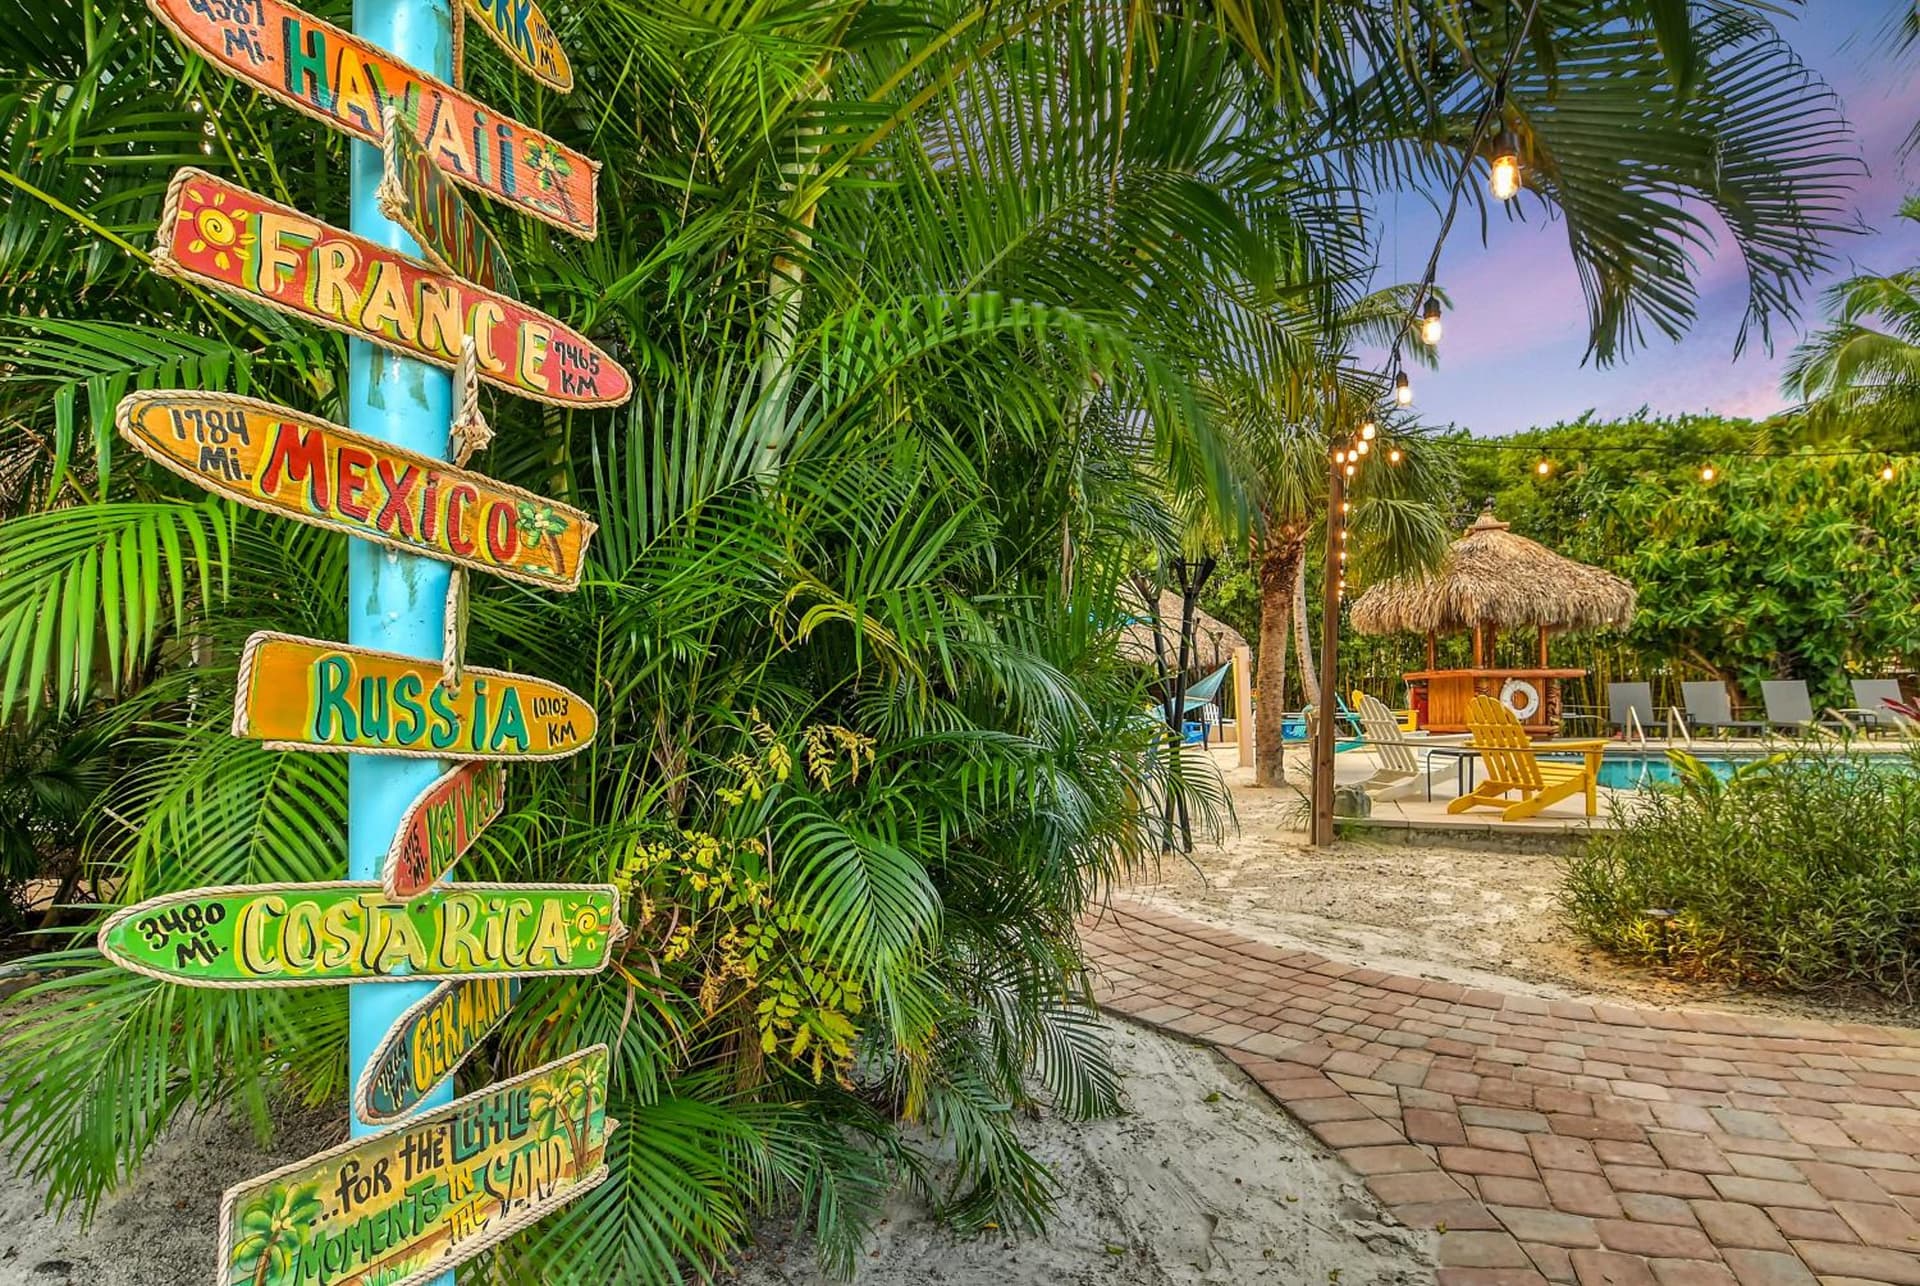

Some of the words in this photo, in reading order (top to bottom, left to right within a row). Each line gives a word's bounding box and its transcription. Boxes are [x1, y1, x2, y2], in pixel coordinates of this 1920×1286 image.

[414, 152, 496, 290] CUBA
[246, 211, 549, 393] FRANCE
[553, 340, 600, 375] 7465
[560, 368, 600, 398] KM
[168, 408, 250, 446] 1784
[547, 719, 577, 747] KM
[426, 786, 457, 880] KEY
[137, 902, 226, 950] 3480
[236, 893, 427, 976] COSTA
[292, 1174, 443, 1286] MOMENTS
[446, 1166, 475, 1204] IN
[442, 1192, 488, 1246] THE
[483, 1134, 567, 1219] SAND
